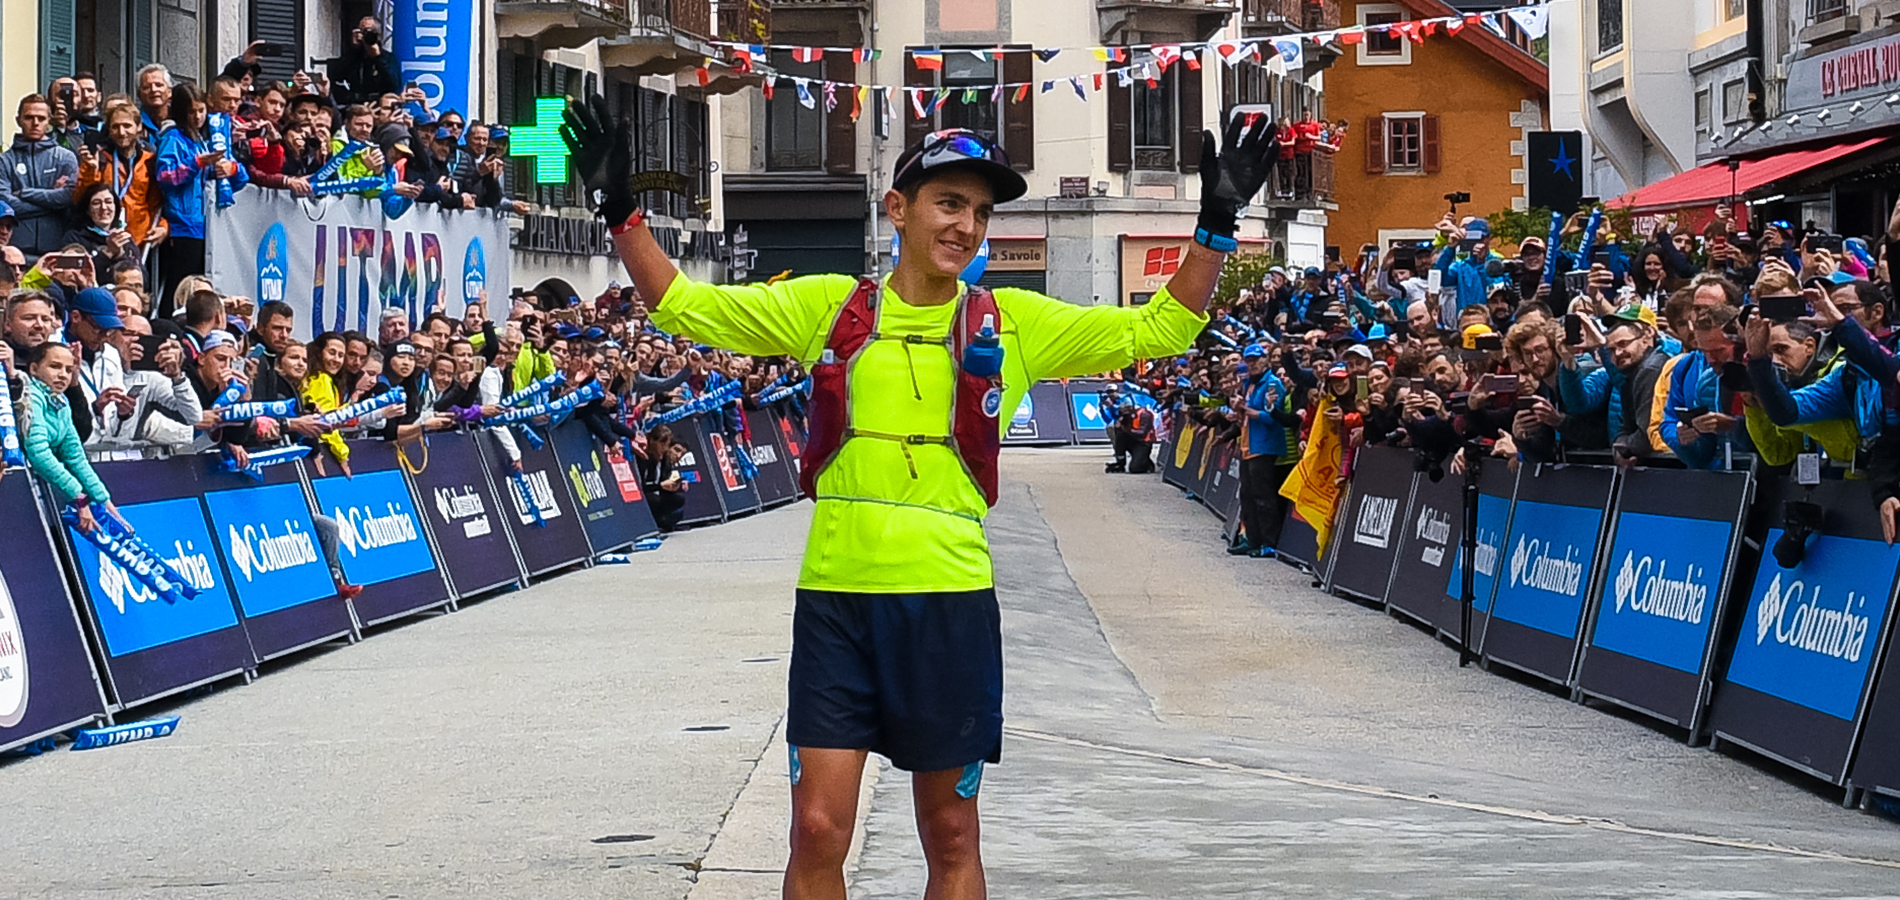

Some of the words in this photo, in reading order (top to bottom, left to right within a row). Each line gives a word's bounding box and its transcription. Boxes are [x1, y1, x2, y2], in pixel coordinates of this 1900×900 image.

[1001, 249, 1041, 261] Savoie
[502, 381, 541, 406] UTMB
[504, 404, 546, 421] UTMB
[243, 519, 318, 573] Columbia
[348, 501, 418, 550] Columbia
[1522, 538, 1583, 597] Columbia
[1630, 556, 1707, 625] Columbia
[1775, 580, 1869, 663] Columbia
